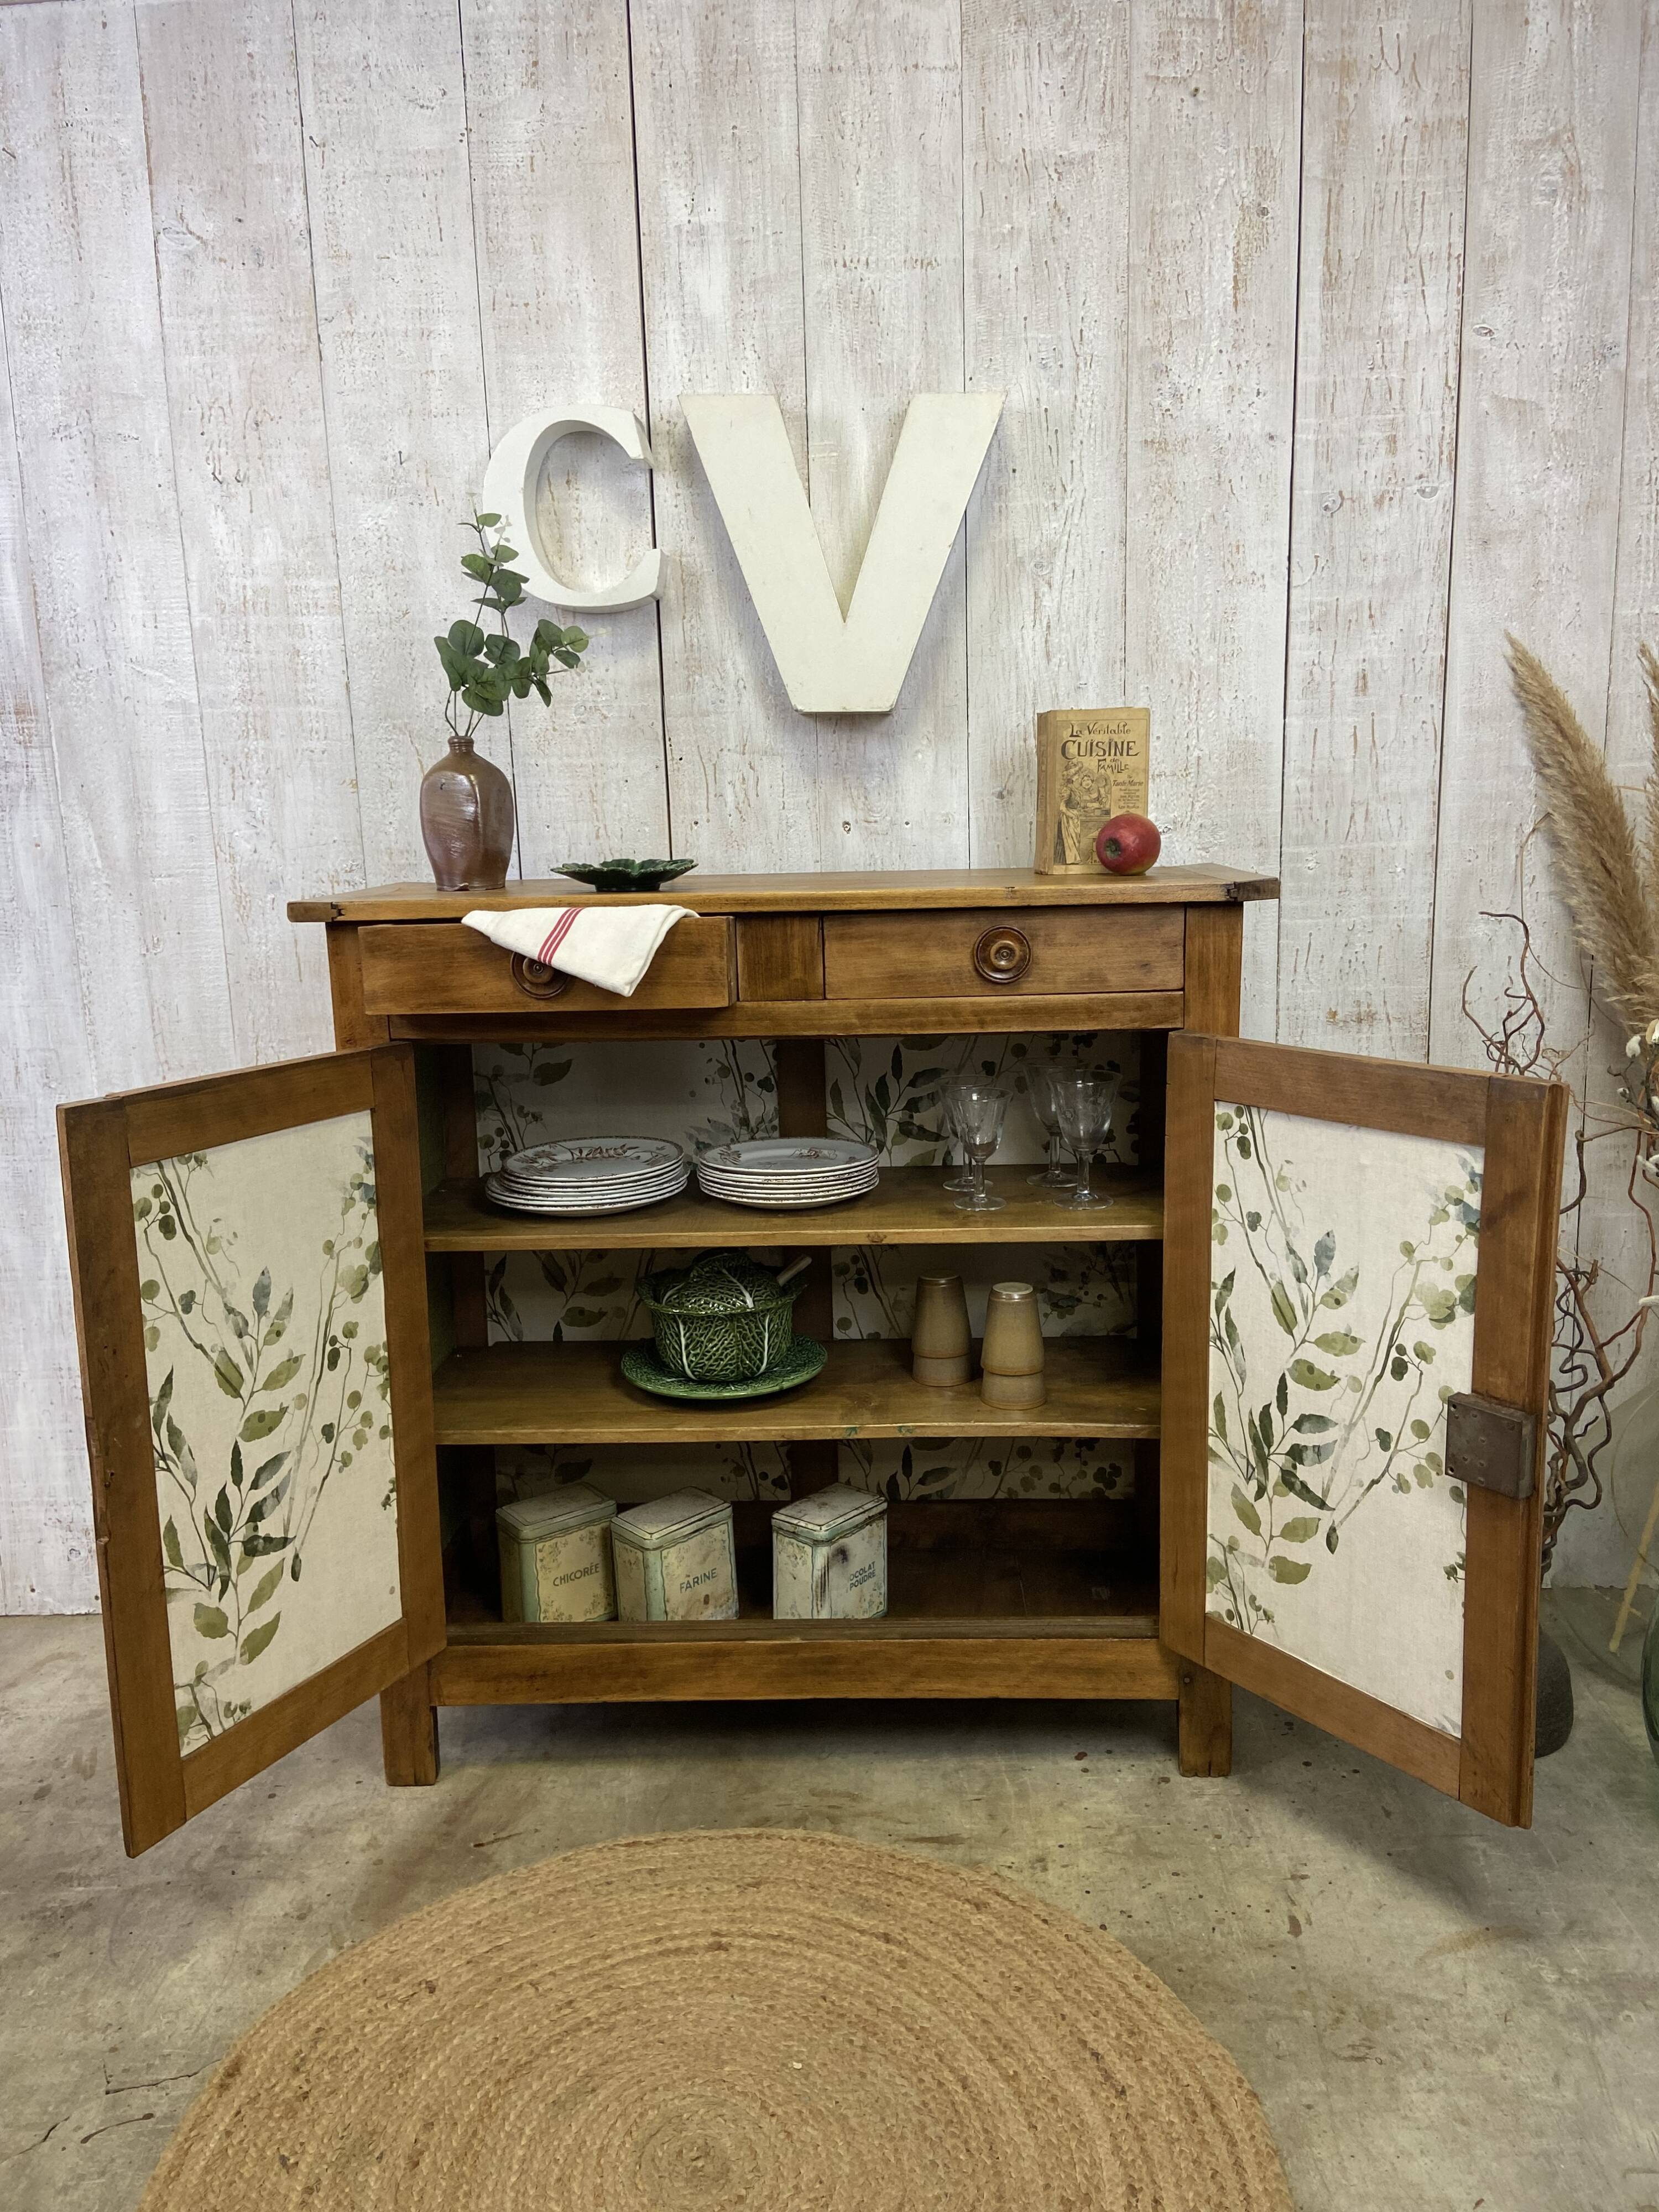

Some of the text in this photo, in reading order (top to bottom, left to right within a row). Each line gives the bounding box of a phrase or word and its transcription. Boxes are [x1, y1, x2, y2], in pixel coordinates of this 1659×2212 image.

[1069, 722, 1083, 738] La
[1061, 739, 1141, 760] CUISINE
[1097, 758, 1129, 774] FAMILLE
[552, 1562, 599, 1587] CHICORÉE
[680, 1567, 717, 1593] FARINE
[849, 1561, 875, 1581] OCOLAT
[849, 1569, 876, 1591] POUDRE
